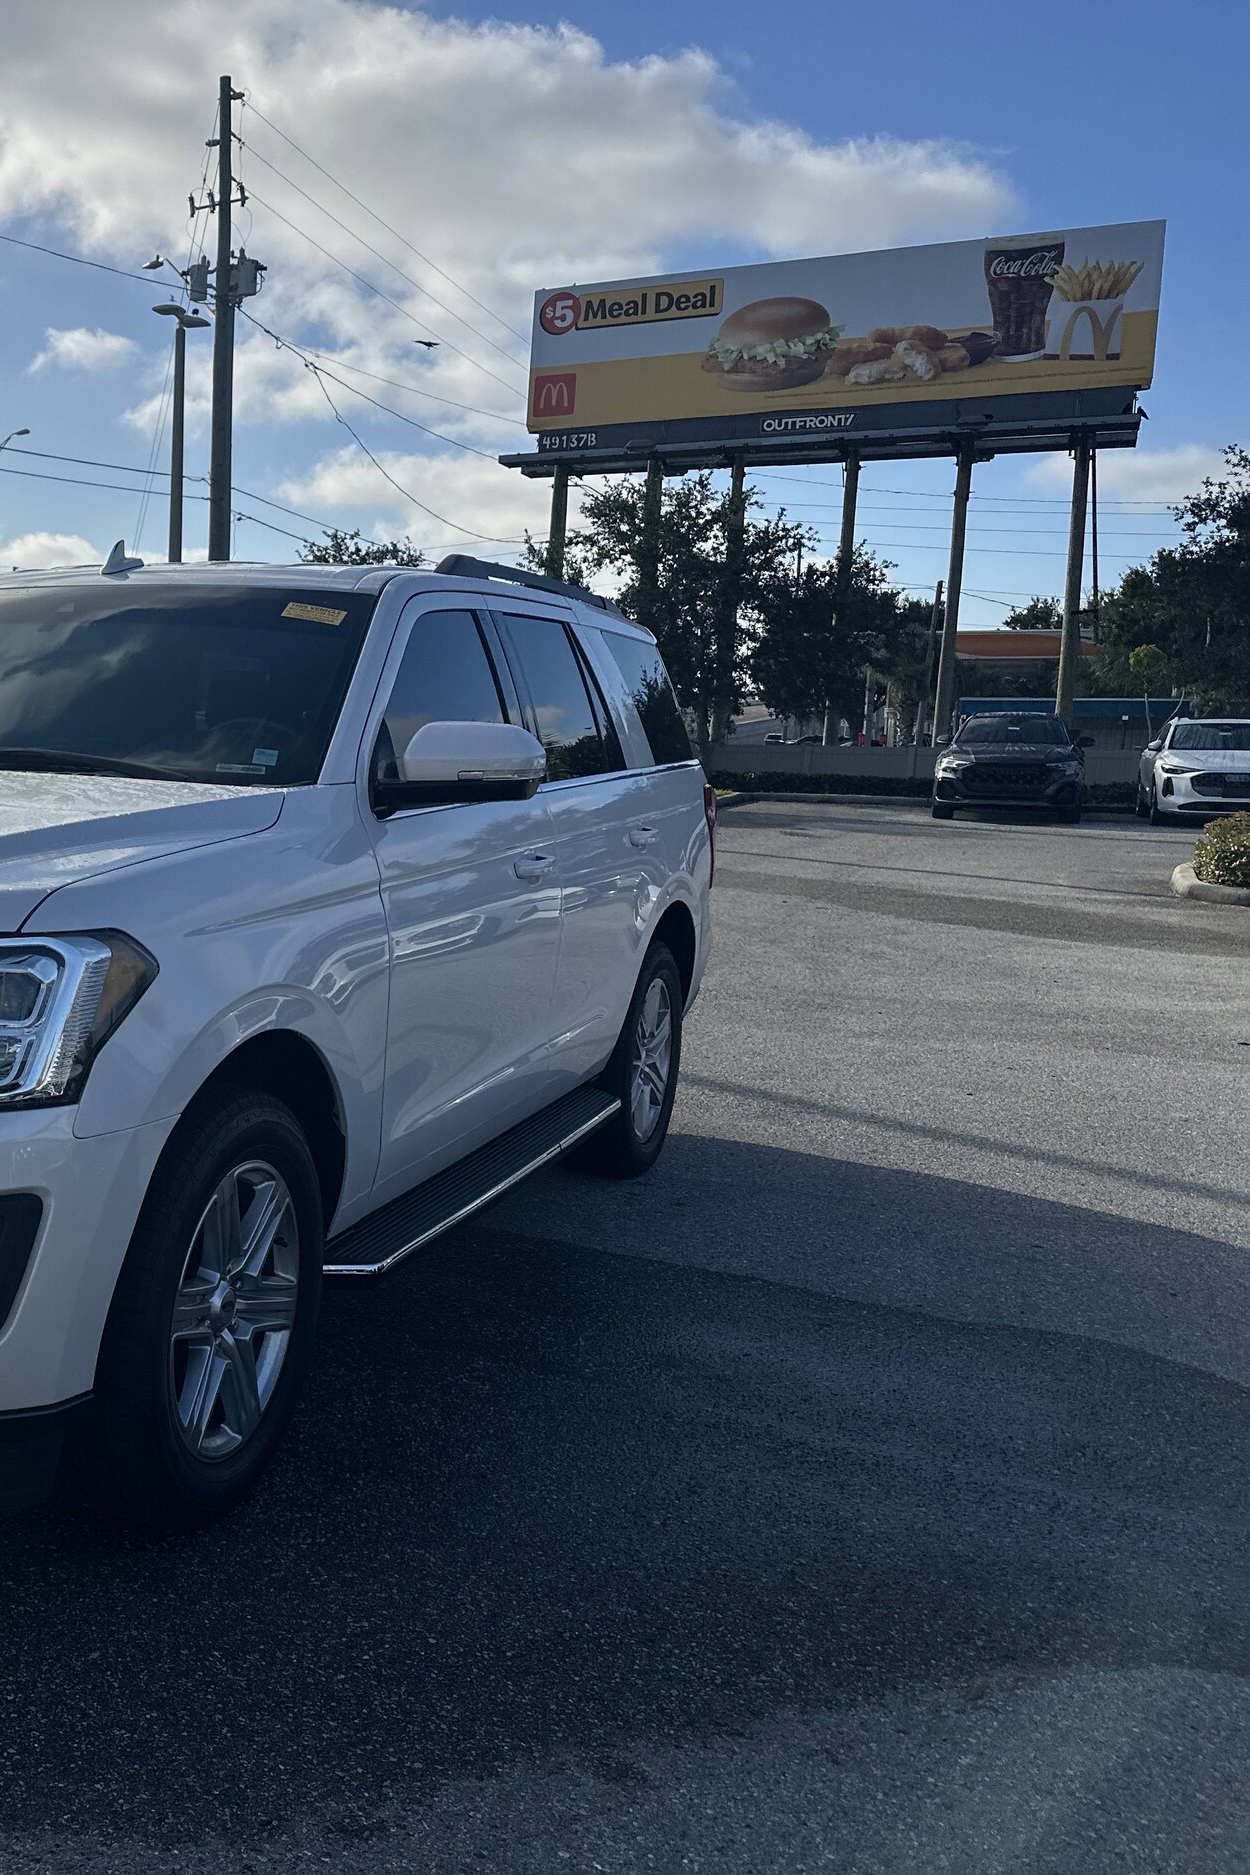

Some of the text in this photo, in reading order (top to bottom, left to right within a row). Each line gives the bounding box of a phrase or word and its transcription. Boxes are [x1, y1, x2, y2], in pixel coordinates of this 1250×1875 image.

[545, 285, 716, 328] $5 Meal Deal
